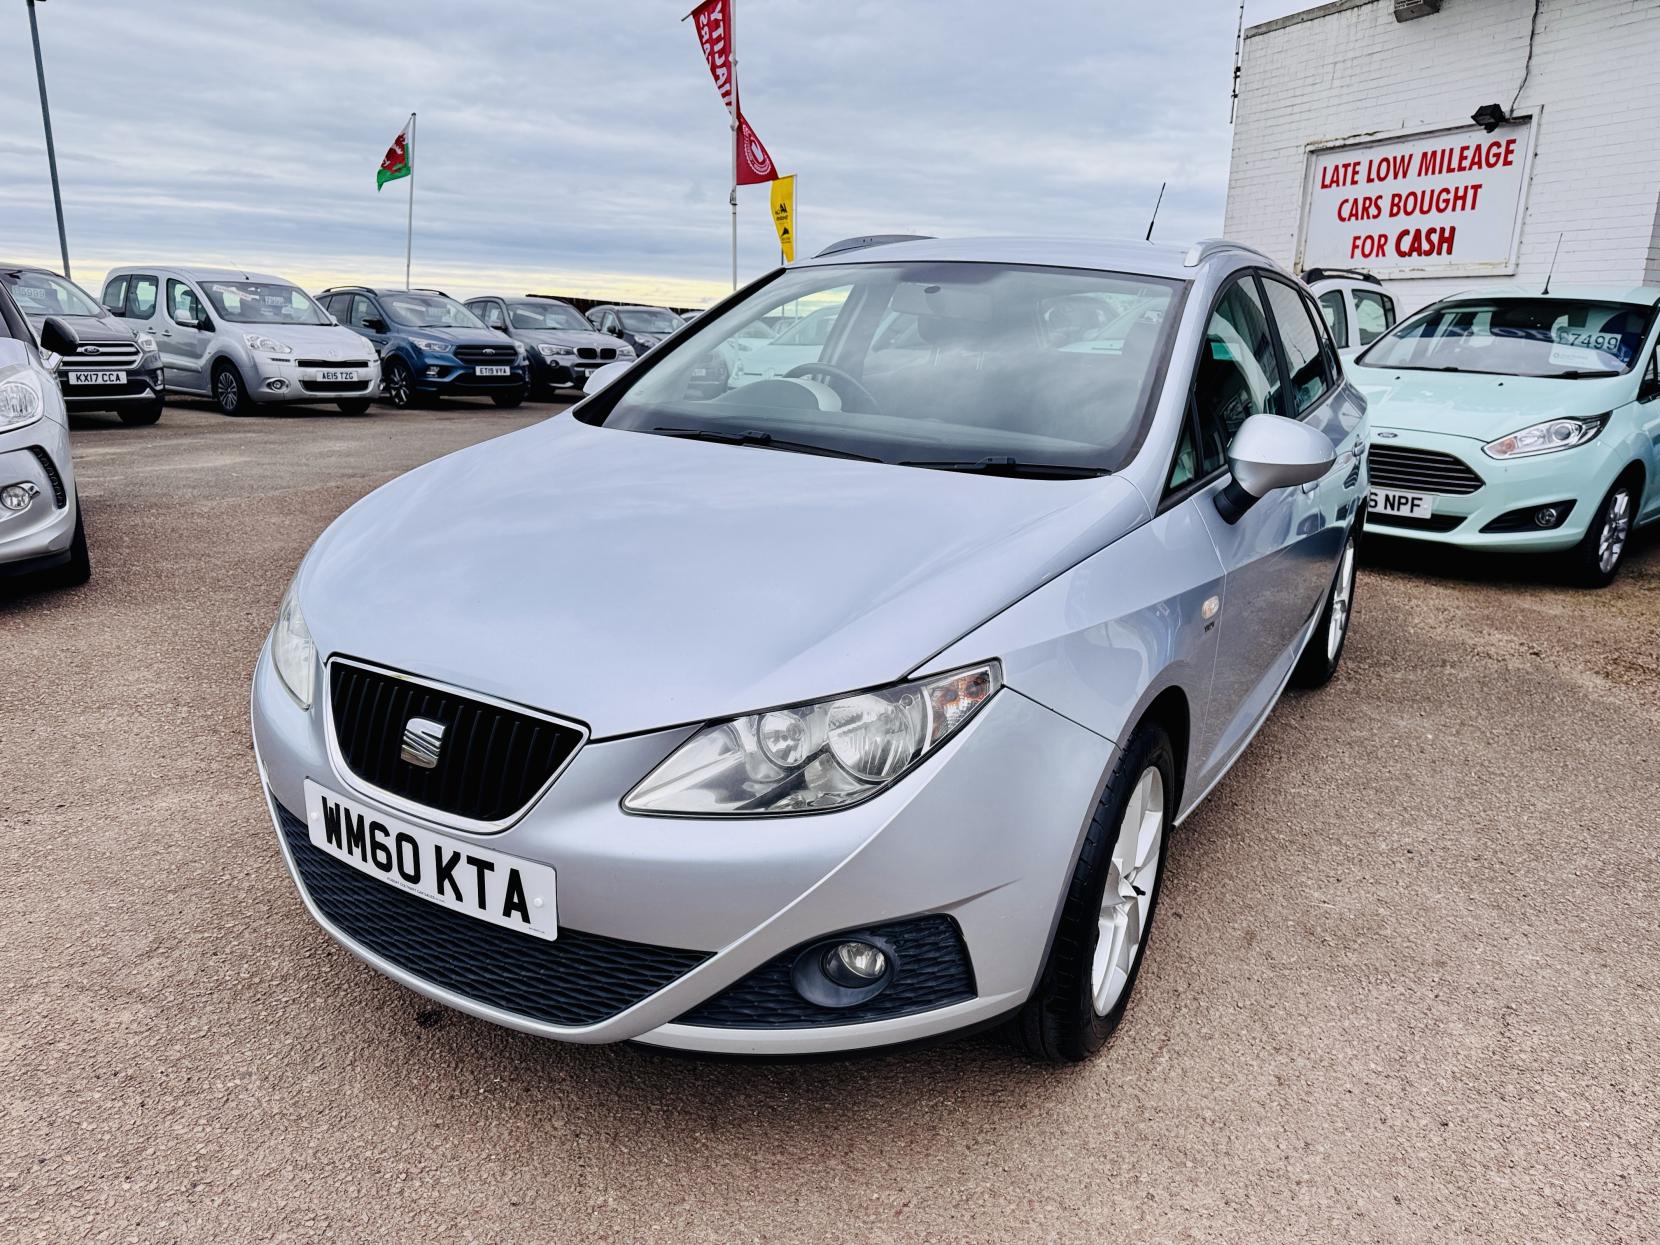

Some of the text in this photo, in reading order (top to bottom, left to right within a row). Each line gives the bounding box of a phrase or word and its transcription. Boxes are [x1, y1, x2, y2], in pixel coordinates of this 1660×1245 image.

[1320, 138, 1517, 189] LATE LOW MILEAGE
[1337, 183, 1482, 222] CARS BOUGHT
[1350, 225, 1456, 259] FOR CASH
[75, 373, 121, 383] KX17 CCA
[322, 371, 354, 380] AE15 TZG
[1384, 493, 1423, 513] NPF
[321, 795, 531, 924] WM60 KTA
